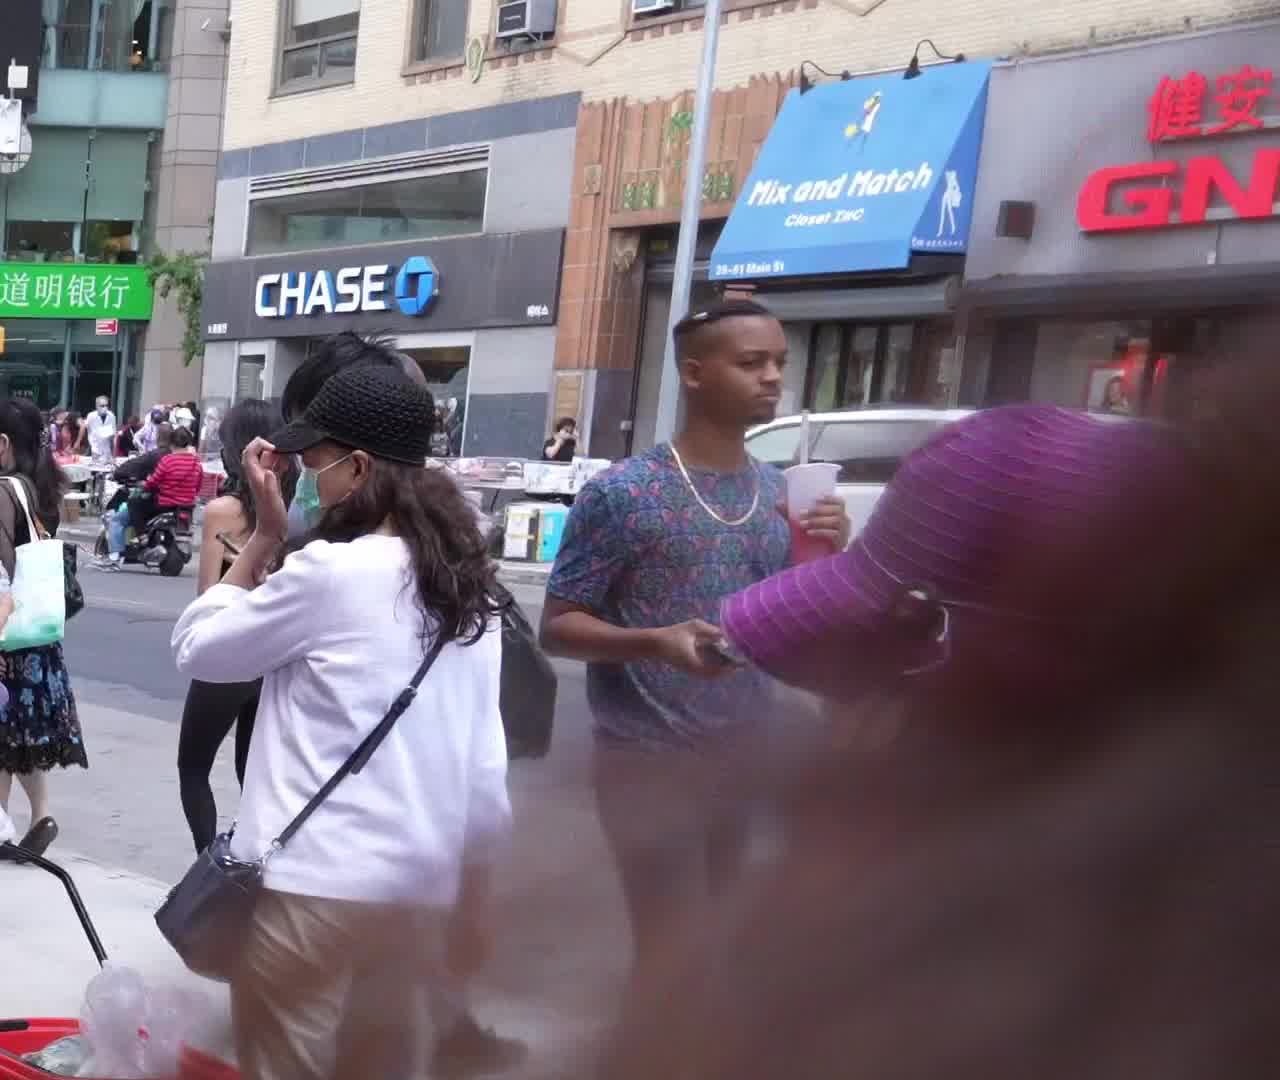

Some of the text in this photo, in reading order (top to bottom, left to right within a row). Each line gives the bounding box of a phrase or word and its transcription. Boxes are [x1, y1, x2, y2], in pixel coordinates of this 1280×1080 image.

[747, 161, 934, 206] Mix and Match
[0, 272, 131, 309] 道明银行
[255, 264, 388, 317] CHASE
